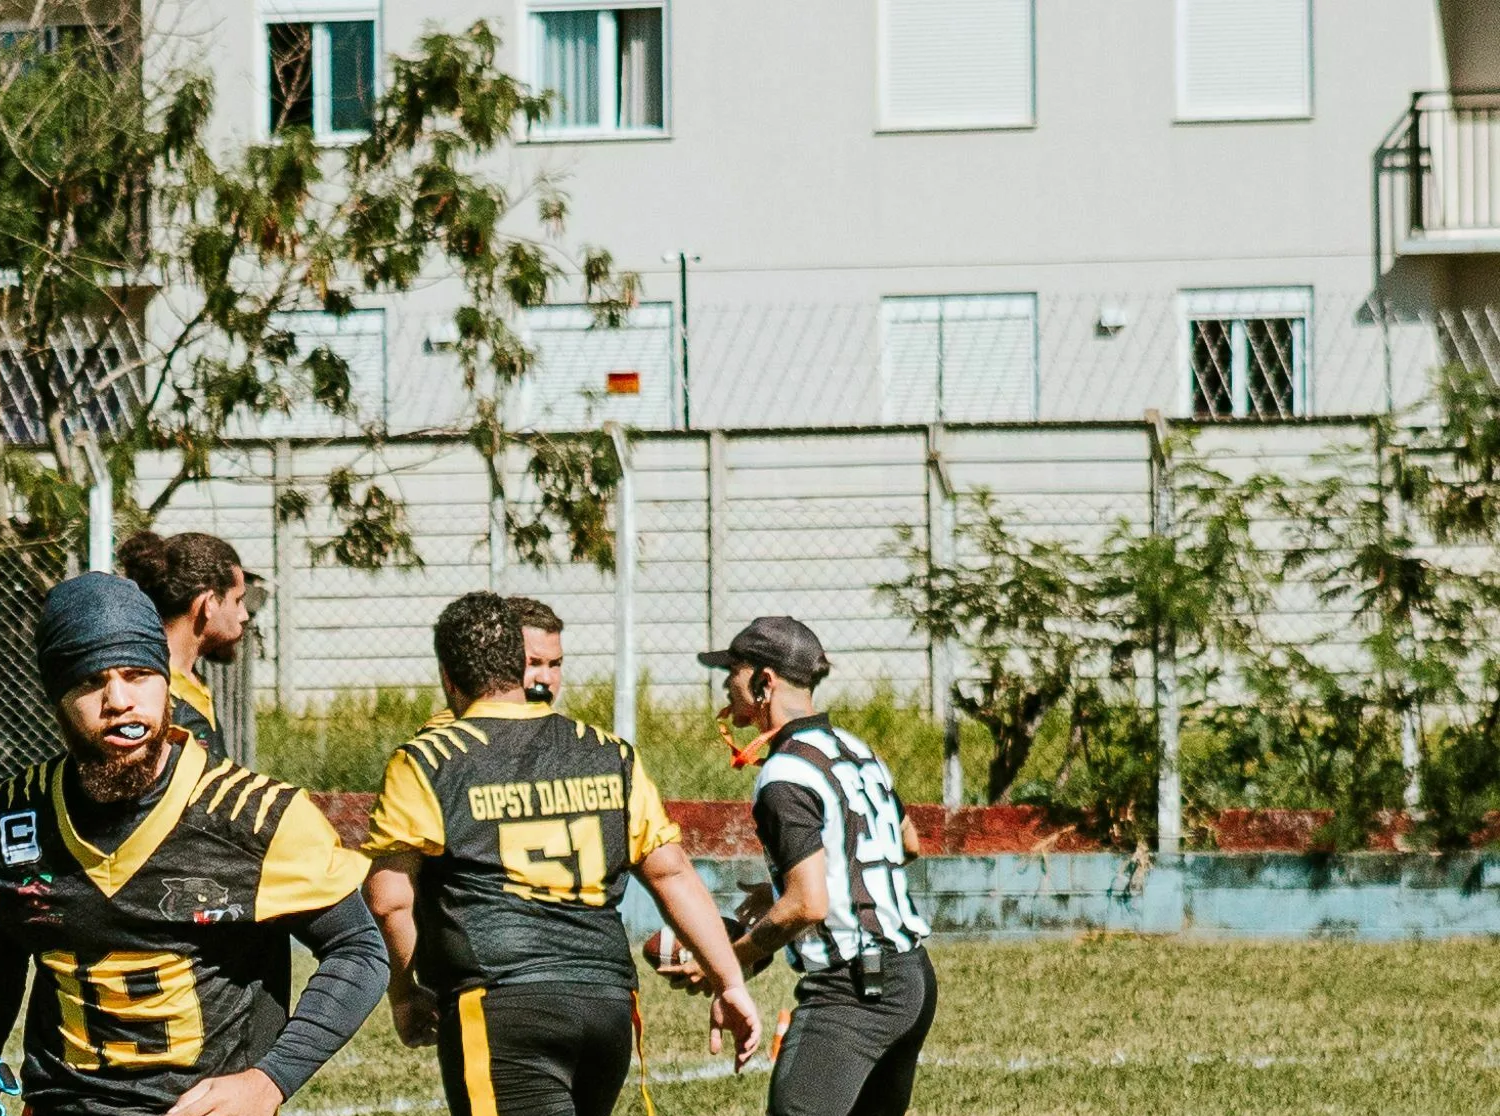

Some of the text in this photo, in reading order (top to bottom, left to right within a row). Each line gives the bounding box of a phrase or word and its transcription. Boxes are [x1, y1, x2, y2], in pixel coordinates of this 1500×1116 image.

[468, 773, 625, 821] GIPSY DANGER
[498, 815, 607, 907] 51
[41, 951, 204, 1071] 19
